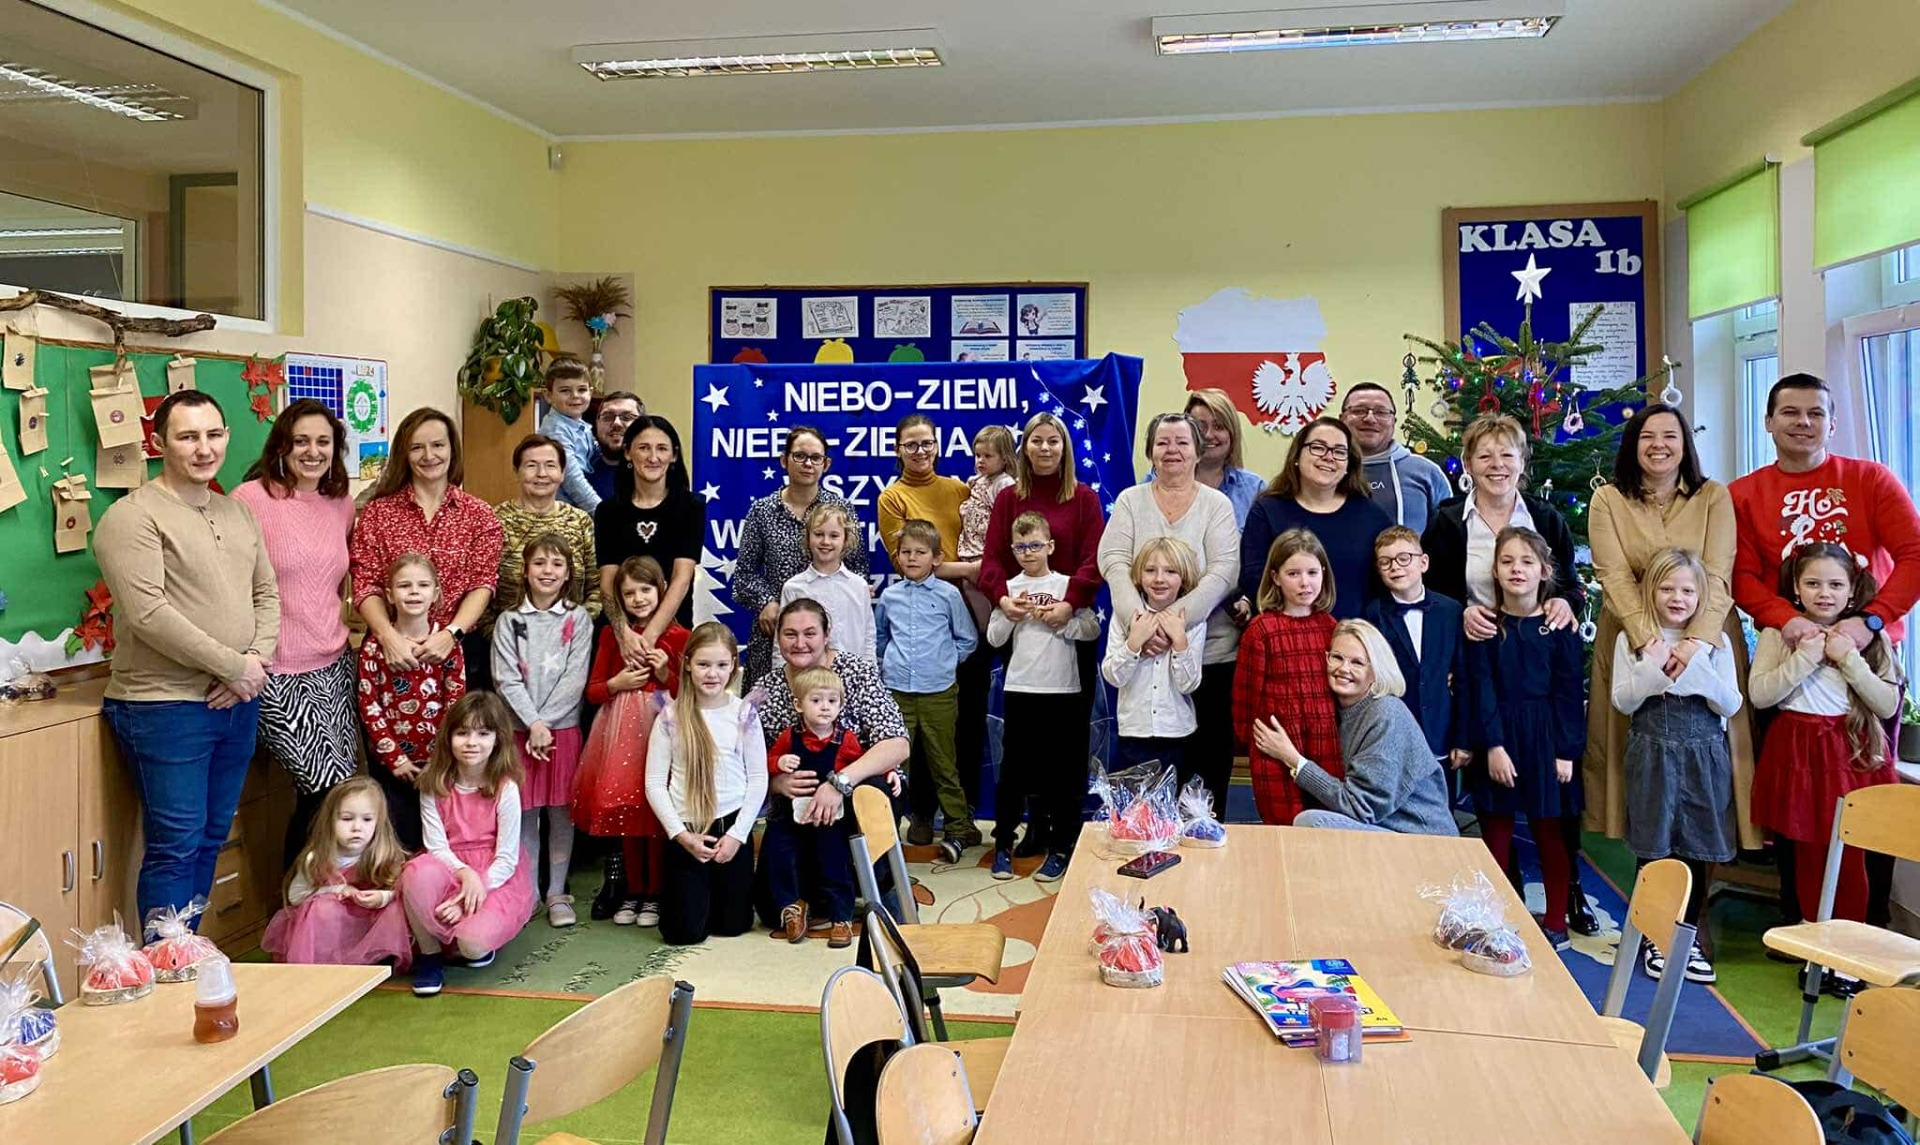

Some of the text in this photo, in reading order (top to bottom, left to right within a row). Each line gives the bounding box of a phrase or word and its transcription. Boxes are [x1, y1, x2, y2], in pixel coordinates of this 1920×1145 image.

[1459, 219, 1606, 252] KLASA
[1595, 248, 1642, 276] 1b
[784, 378, 1029, 413] NIEBO-ZIEMI,
